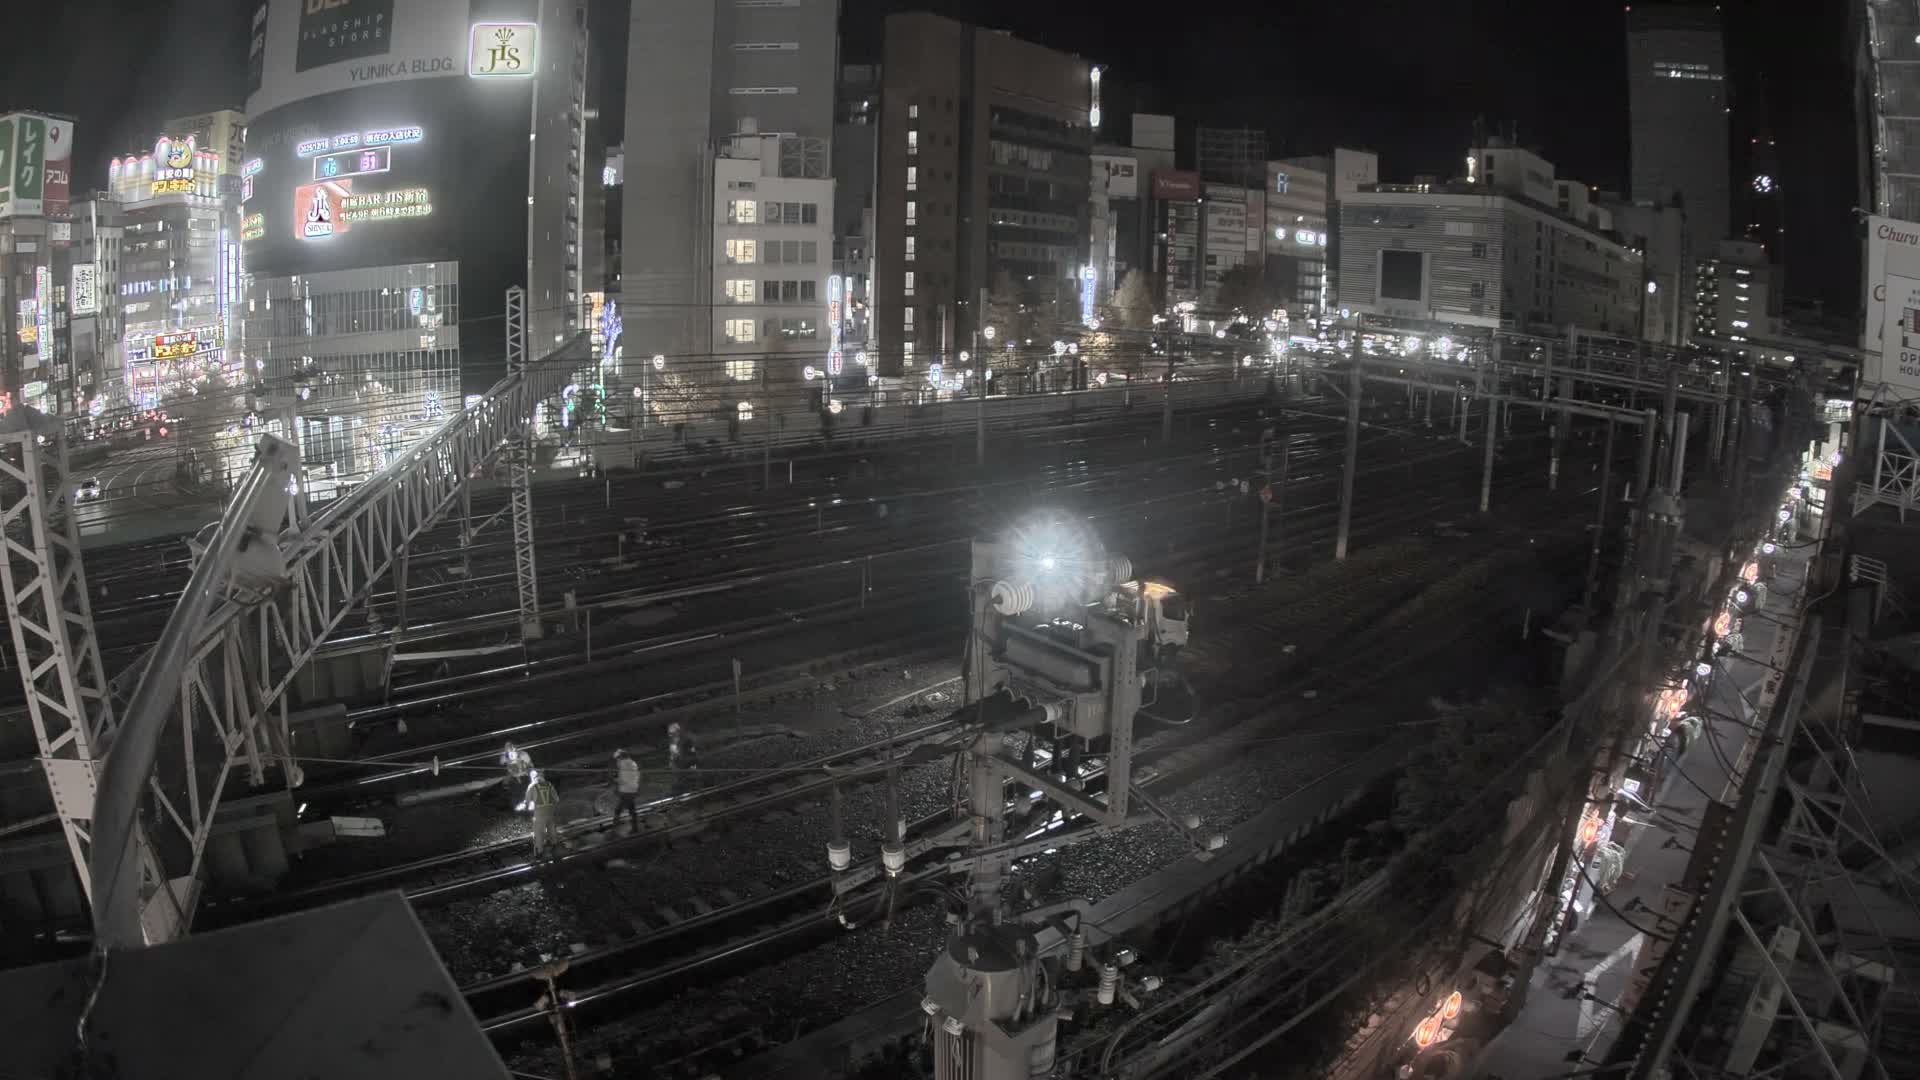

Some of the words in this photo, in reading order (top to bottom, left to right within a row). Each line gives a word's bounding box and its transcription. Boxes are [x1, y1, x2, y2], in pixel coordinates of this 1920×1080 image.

[328, 28, 384, 48] STORE
[480, 44, 521, 73] JIS
[350, 61, 407, 81] YUNIKA
[20, 120, 38, 188] レイク
[46, 169, 69, 185] アコム
[1877, 224, 1919, 246] Churu
